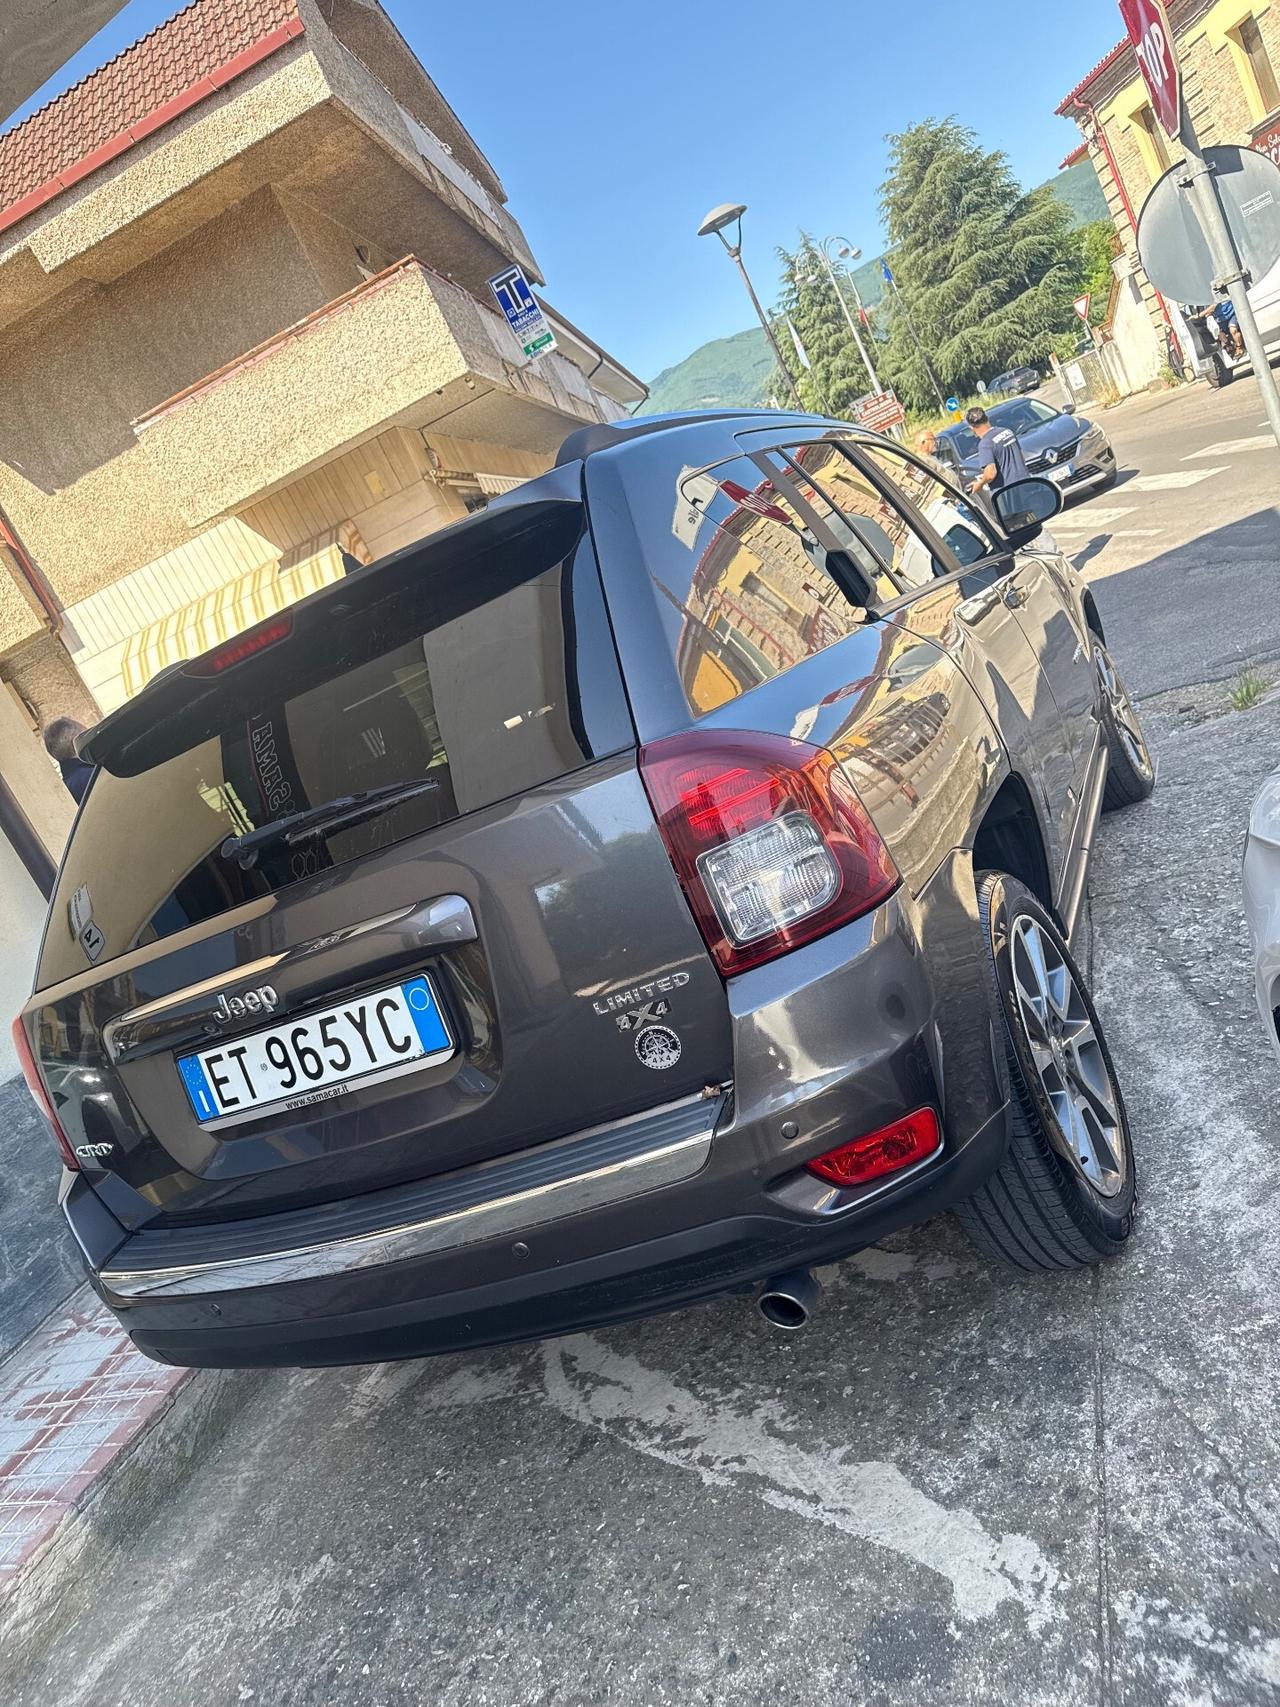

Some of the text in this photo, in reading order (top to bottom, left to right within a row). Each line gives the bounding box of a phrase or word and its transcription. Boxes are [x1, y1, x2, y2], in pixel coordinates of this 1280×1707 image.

[1136, 22, 1169, 93] TOP
[511, 308, 541, 328] TABACCHI
[212, 983, 280, 1025] Jeep
[593, 972, 690, 1016] LIMITED
[204, 1046, 258, 1109] ET
[265, 997, 412, 1090] 965YC
[285, 1084, 349, 1110] www.samacar.it
